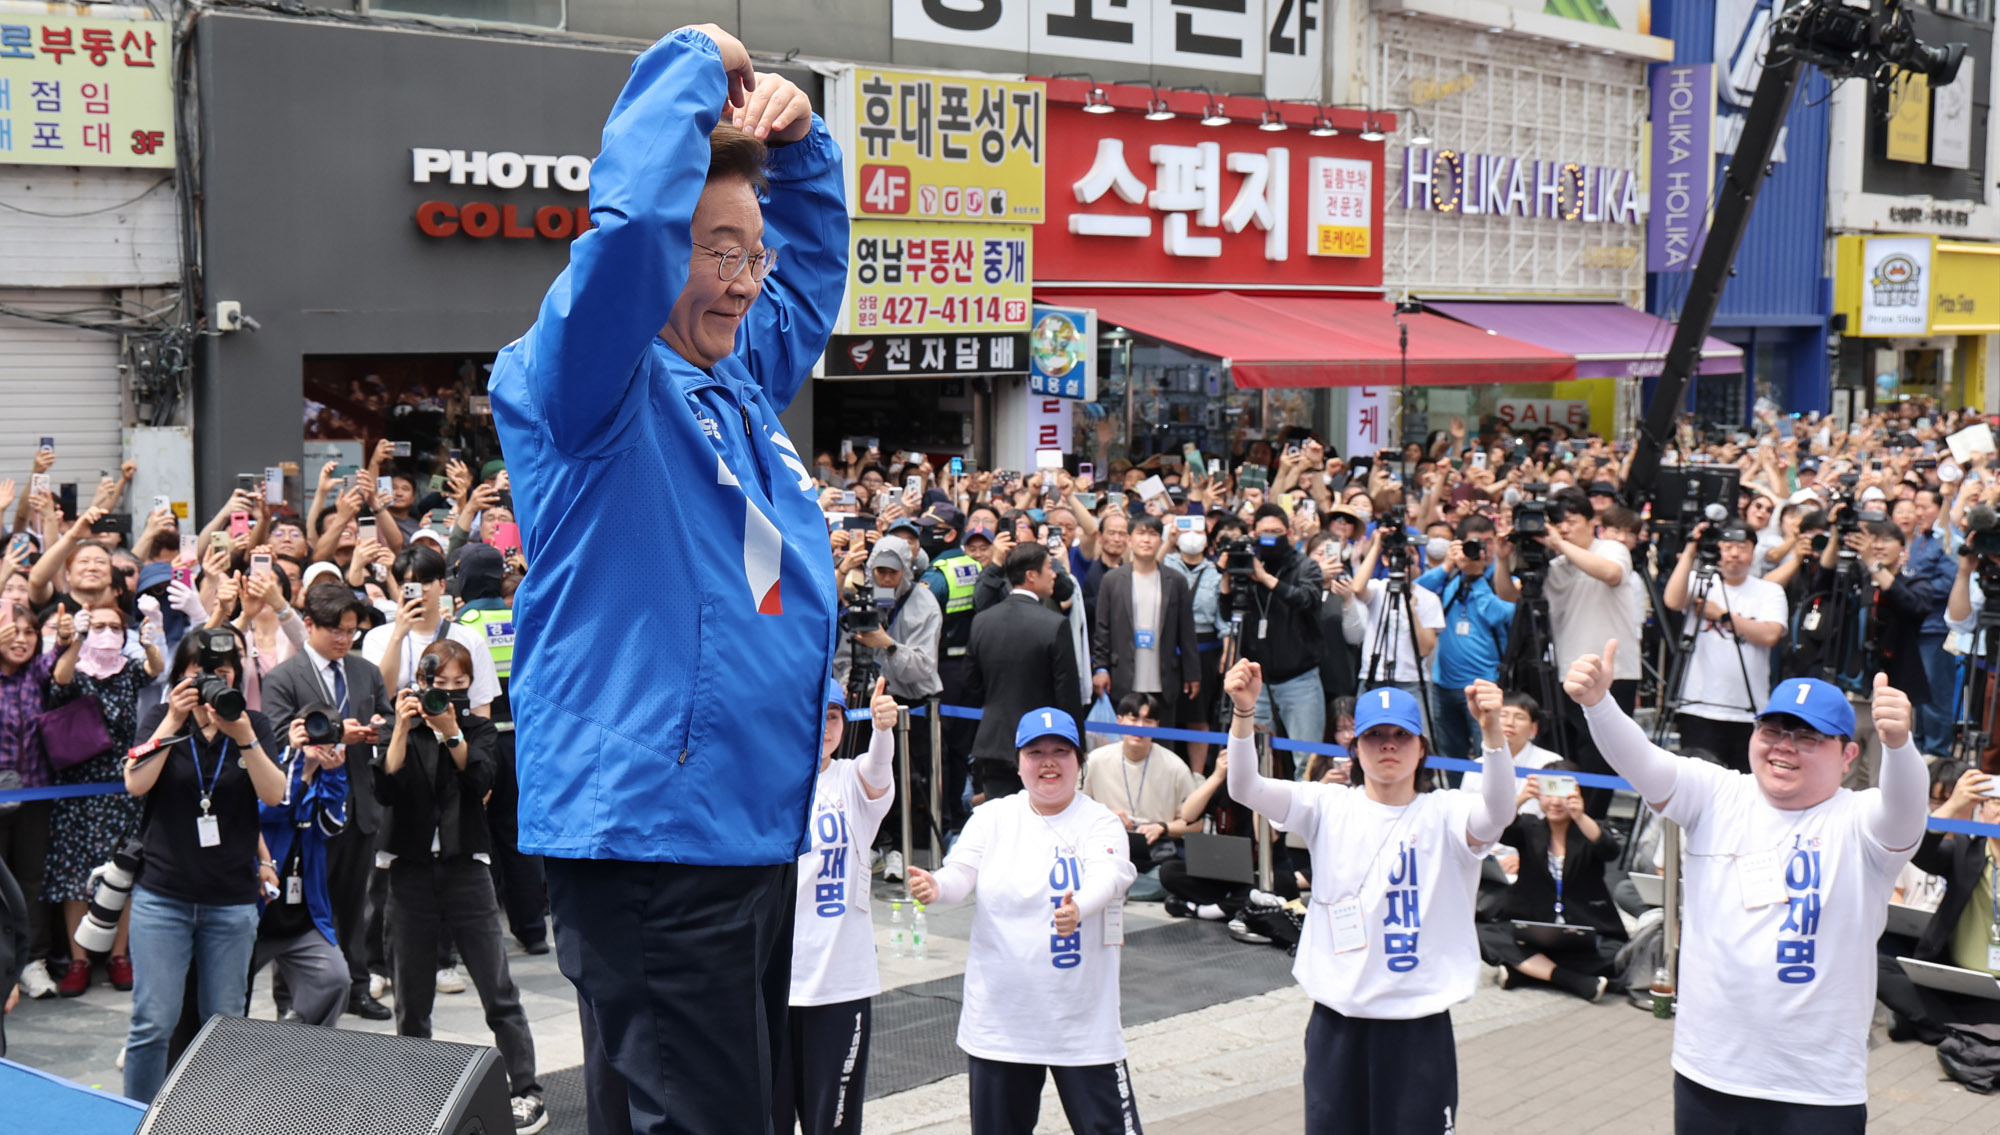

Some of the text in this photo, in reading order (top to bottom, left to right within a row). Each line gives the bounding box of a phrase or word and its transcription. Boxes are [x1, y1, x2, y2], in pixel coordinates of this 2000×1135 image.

[859, 75, 1041, 164] 휴대폰성지
[131, 130, 165, 155] 3F
[411, 147, 598, 192] PHOTO
[865, 168, 906, 211] 4F
[1402, 146, 1641, 225] HOLIKA HOLIKA
[1664, 68, 1694, 268] HOLIKA HOLIKA
[1067, 137, 1290, 262] 스펀지
[856, 238, 1026, 284] 영남부동산 중개
[881, 296, 1001, 326] 427-4114
[1006, 301, 1025, 320] 3F
[884, 336, 1015, 371] 전자담배
[1499, 403, 1585, 427] SALE
[490, 635, 516, 645] POLI
[1377, 690, 1390, 709] 1
[1795, 683, 1812, 705] 1
[1041, 711, 1052, 729] 1
[815, 811, 847, 918] 이재명
[1049, 856, 1082, 970] 이명
[1383, 847, 1421, 973] 이재명
[1776, 850, 1821, 985] 이재명
